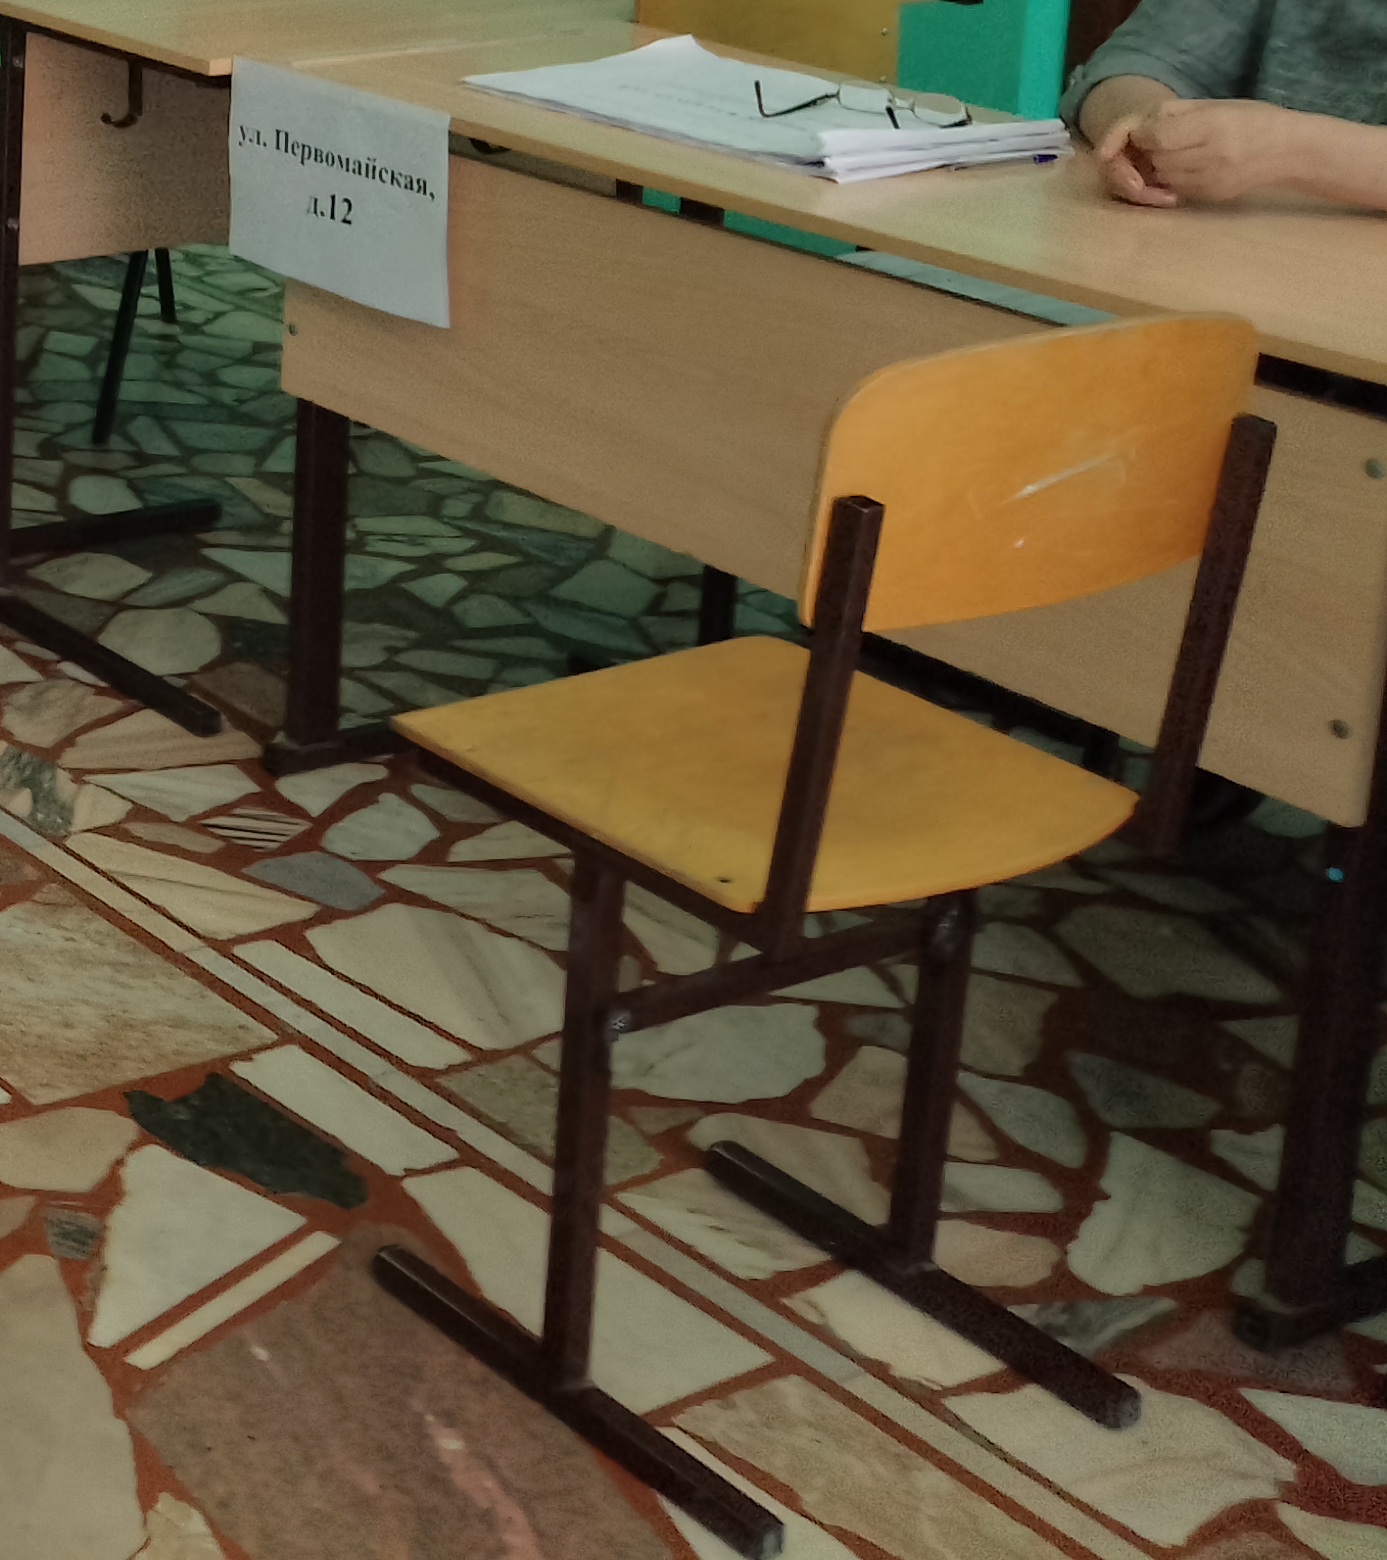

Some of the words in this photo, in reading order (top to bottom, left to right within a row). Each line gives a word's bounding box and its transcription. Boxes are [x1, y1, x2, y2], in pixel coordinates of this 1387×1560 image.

[238, 124, 268, 148] ул.
[275, 128, 436, 202] Первомайская,
[306, 193, 355, 226] д.12
